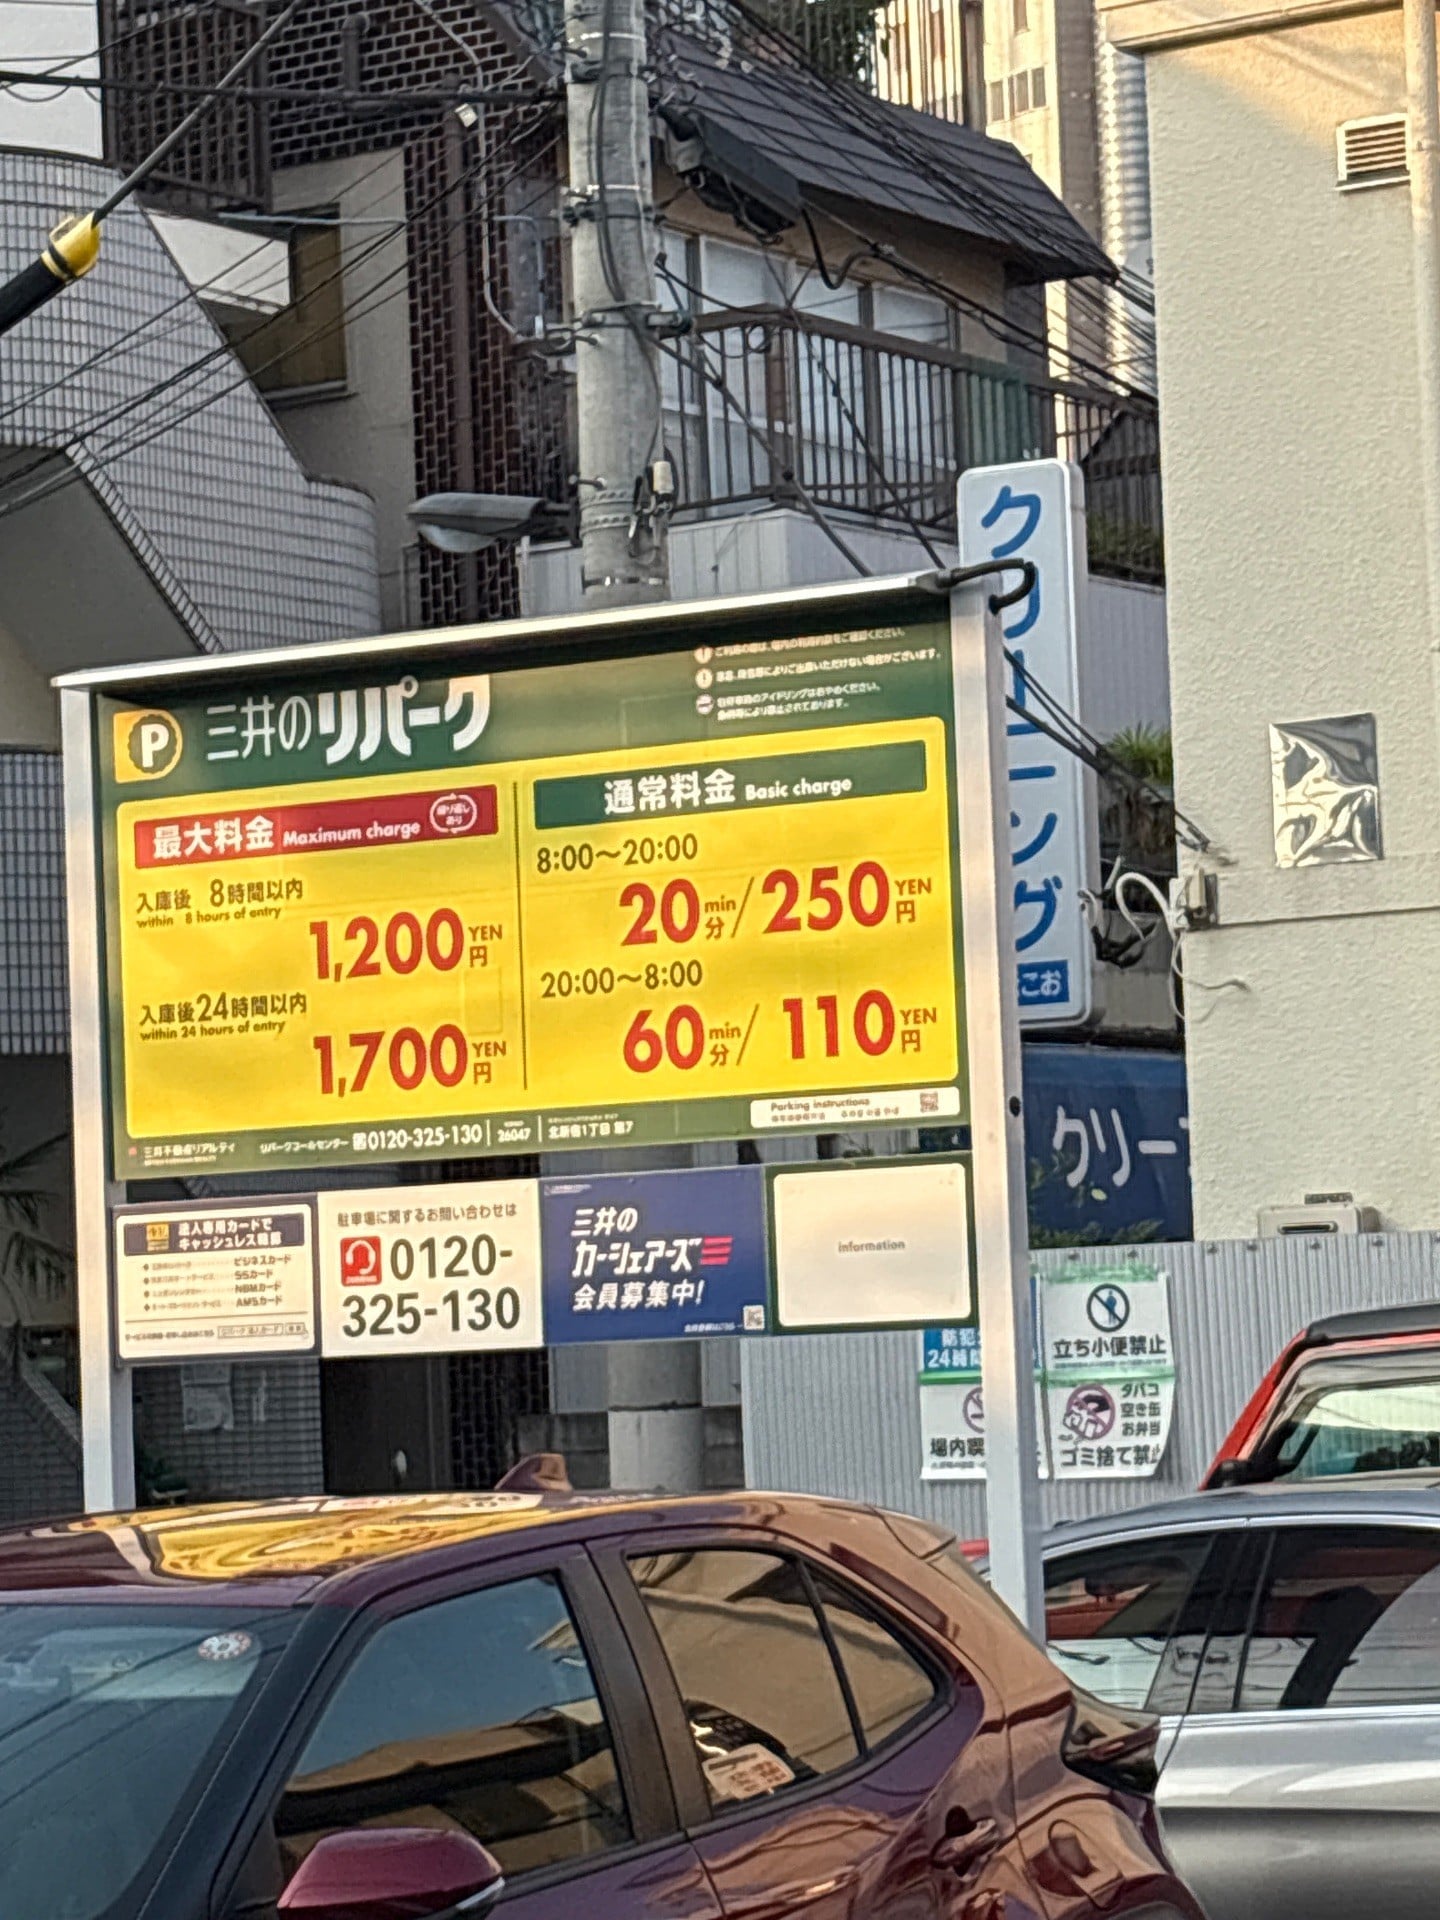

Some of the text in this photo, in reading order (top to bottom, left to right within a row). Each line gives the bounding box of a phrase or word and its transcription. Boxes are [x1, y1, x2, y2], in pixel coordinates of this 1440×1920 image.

[207, 675, 491, 765] 三井のリパーク
[603, 768, 736, 815] 通常料金
[745, 776, 853, 801] Basic charge
[153, 815, 274, 859] 最大料金
[283, 820, 421, 847] Maximum charge
[137, 877, 304, 914] 入庫後 8時間以内
[619, 878, 700, 946] 20
[705, 897, 736, 914] min
[762, 861, 890, 934] 250
[895, 877, 932, 897] YEN
[137, 906, 282, 928] within 8 hours of entry
[706, 901, 916, 940] 分 円
[310, 908, 503, 982] 1,200 YEN
[470, 945, 488, 968] 円
[139, 992, 307, 1026] 入庫後24時間以内
[140, 1020, 286, 1041] within 24 hours of entry
[623, 1004, 705, 1074] 60
[709, 1022, 741, 1040] min
[783, 989, 895, 1060] 110
[901, 1007, 937, 1025] YEN
[313, 1022, 507, 1097] 1,700 YEN
[710, 1030, 922, 1067] 分 円
[473, 1061, 492, 1084] 円
[771, 1098, 870, 1112] Parking instructions
[367, 1123, 483, 1150] 0120-325-130
[497, 1127, 532, 1143] 26047
[1053, 1105, 1188, 1189] クリー
[338, 1203, 517, 1228] 駐車場に関するお問い合わせは
[571, 1206, 638, 1237] 三井の
[390, 1233, 513, 1281] 0120-
[571, 1237, 703, 1278] カーシェアーズ
[838, 1239, 906, 1252] information
[234, 1254, 291, 1267] ビジネスカード
[342, 1287, 521, 1337] 325-130
[941, 1328, 981, 1347] 防犯
[1053, 1333, 1167, 1359] 立ち小便禁止
[1121, 1383, 1160, 1398] タバコ
[1120, 1402, 1161, 1418] 空き缶
[1121, 1421, 1161, 1437] お弁当
[1061, 1443, 1160, 1467] ゴミ捨て禁止
